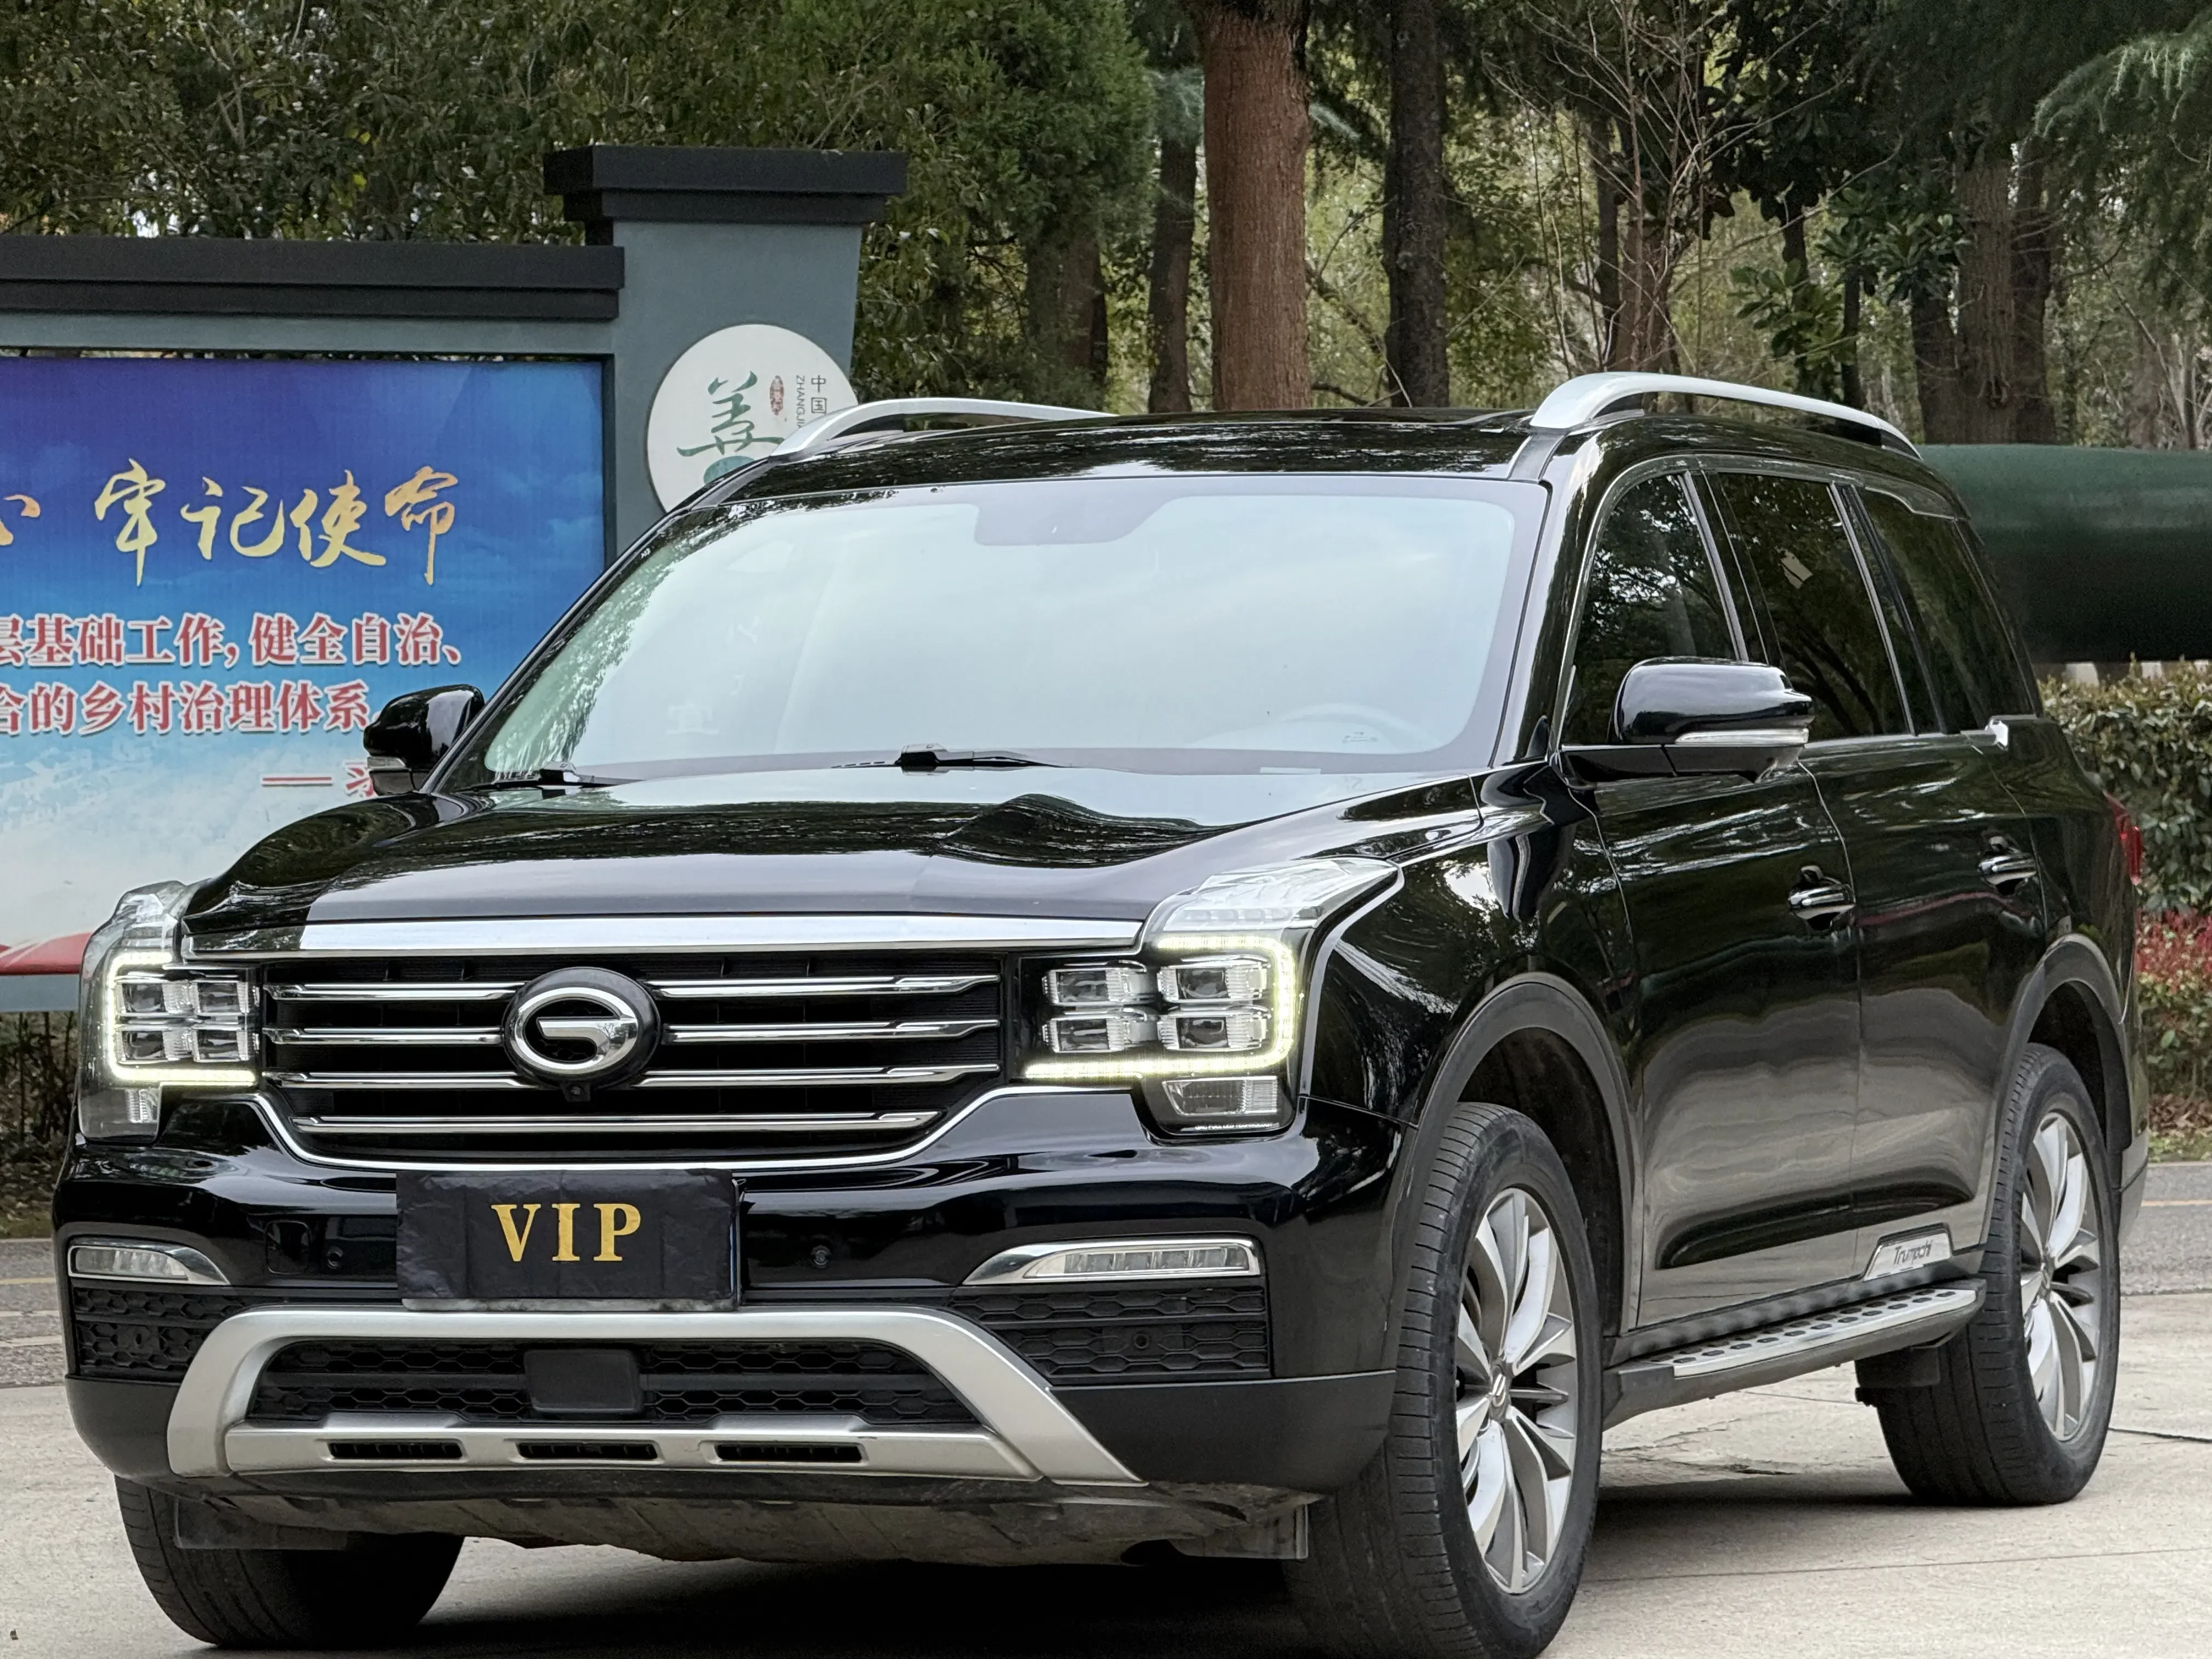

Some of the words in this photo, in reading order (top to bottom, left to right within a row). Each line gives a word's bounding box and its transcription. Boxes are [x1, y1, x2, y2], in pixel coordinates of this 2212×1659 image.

[94, 458, 459, 587] 牢记使命
[491, 1203, 641, 1262] VIP
